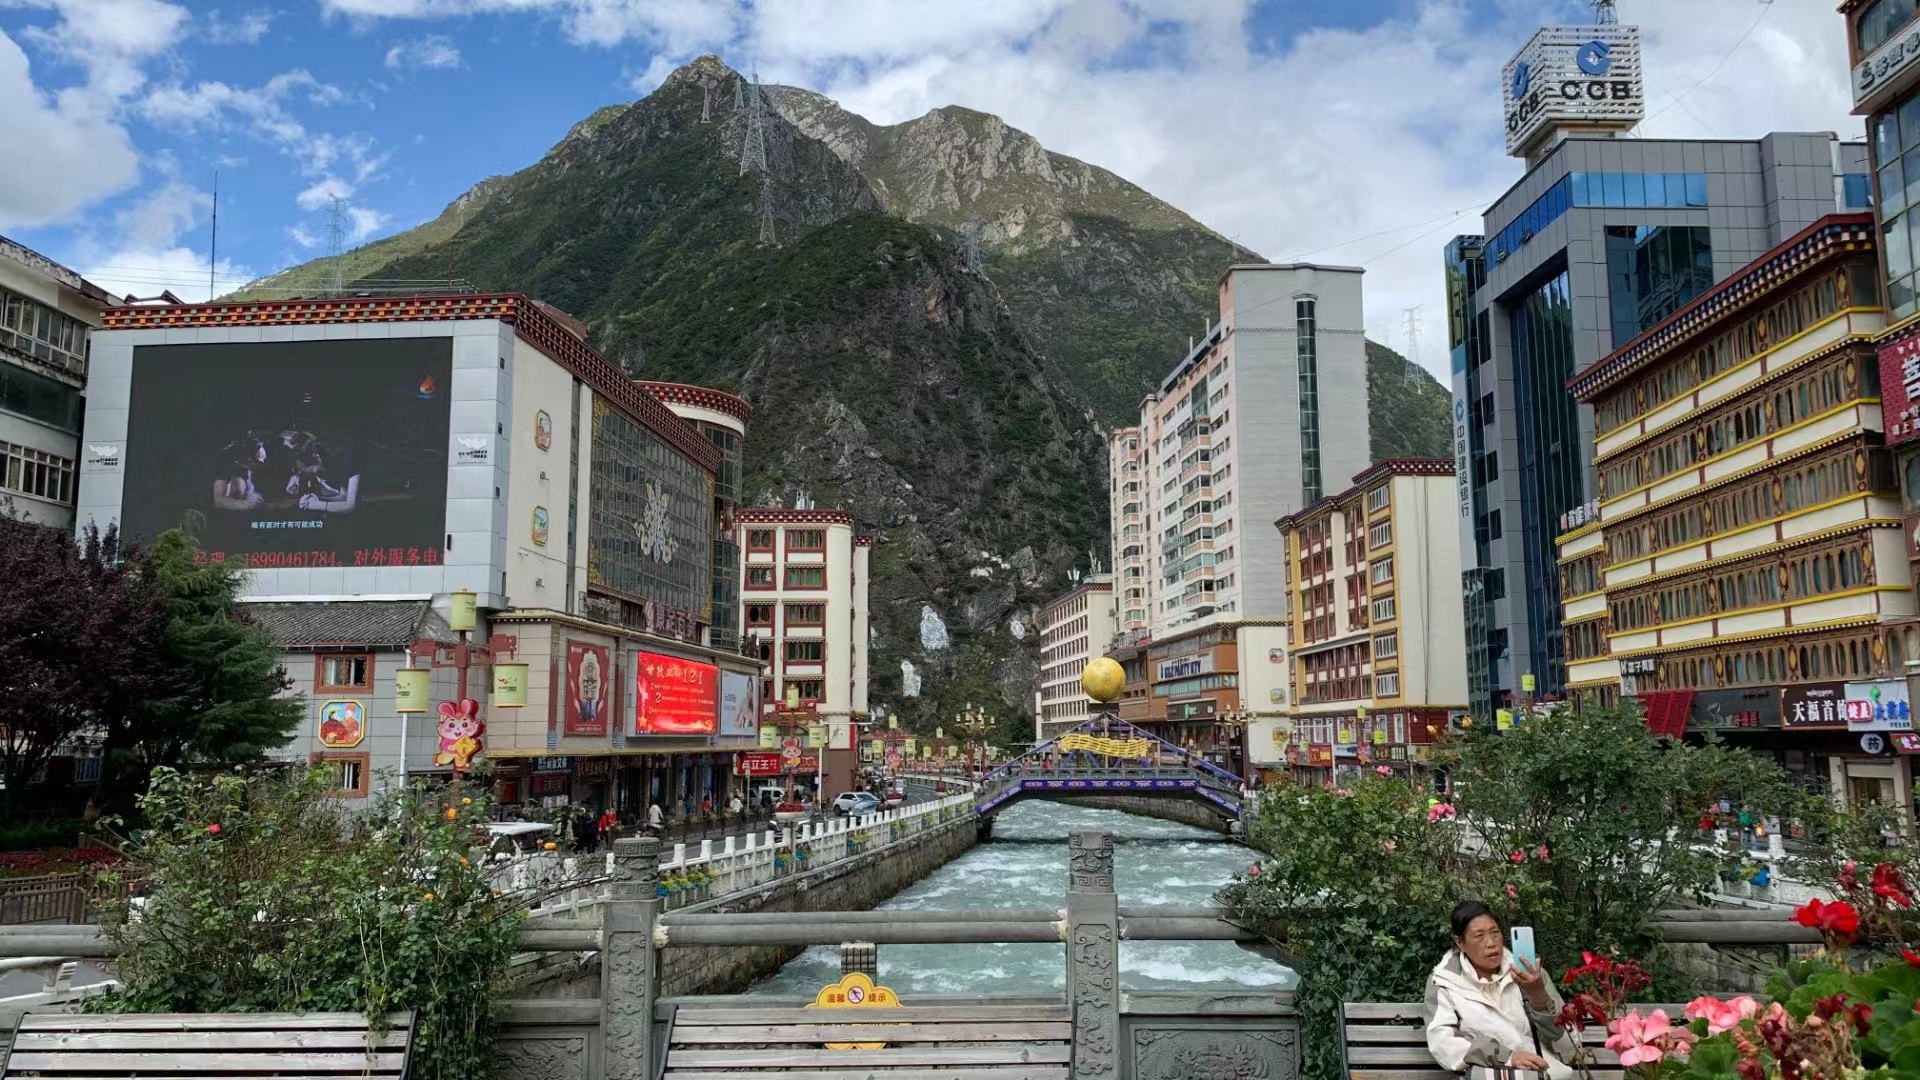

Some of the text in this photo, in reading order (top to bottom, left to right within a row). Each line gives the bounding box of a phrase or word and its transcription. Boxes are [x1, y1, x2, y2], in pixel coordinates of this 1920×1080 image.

[1561, 80, 1630, 100] CCB
[1508, 91, 1539, 132] CCB
[1456, 425, 1470, 518] 中国建设银行
[826, 993, 886, 1003] 温馨 提示
